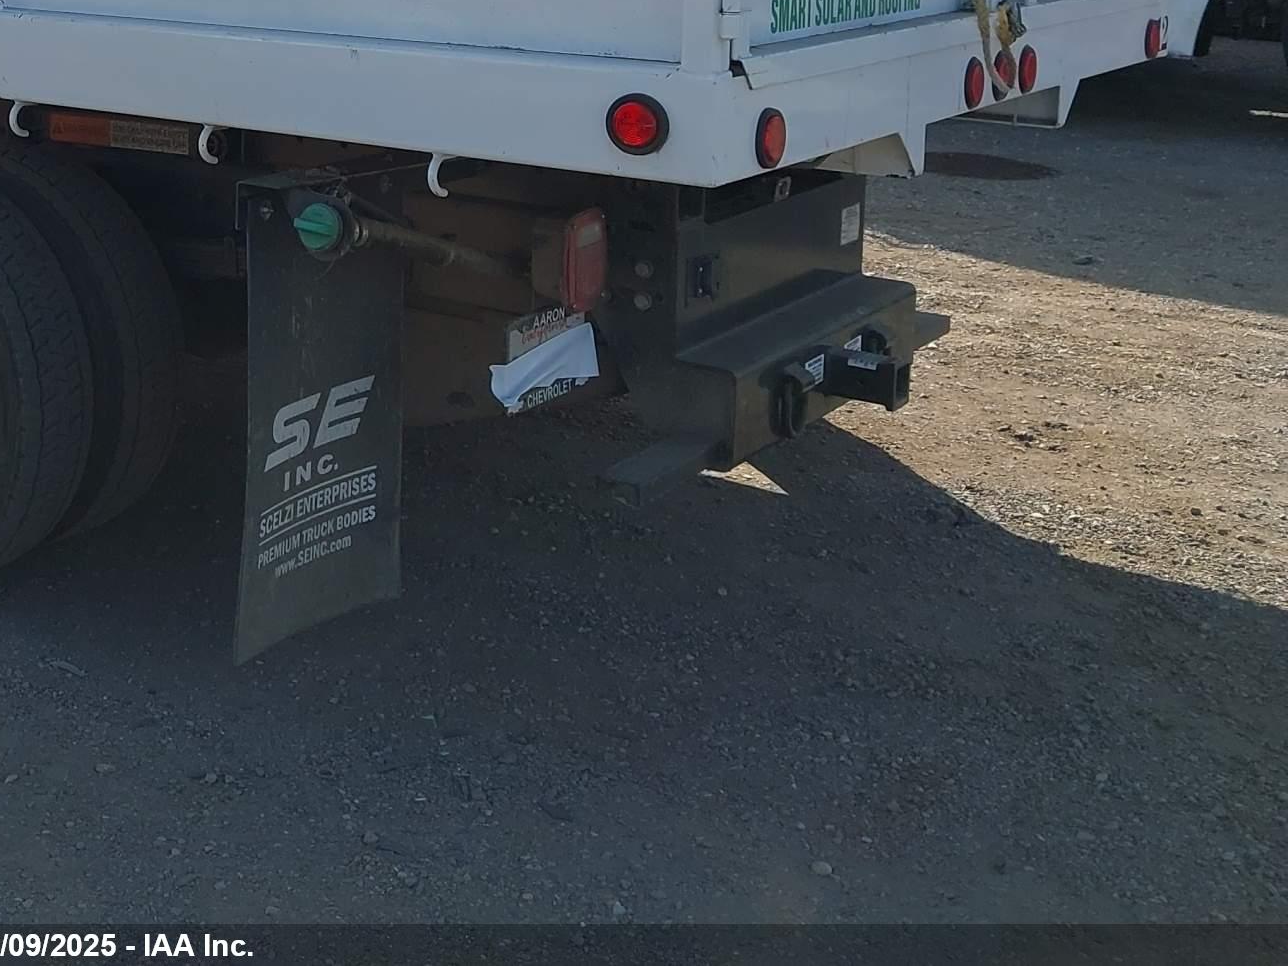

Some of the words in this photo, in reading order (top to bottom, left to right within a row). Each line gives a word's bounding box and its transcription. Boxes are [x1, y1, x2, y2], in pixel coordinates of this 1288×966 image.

[533, 307, 565, 330] AARON
[527, 378, 572, 409] CHEVROLET
[264, 374, 375, 473] SE
[283, 454, 339, 492] INC.
[259, 503, 294, 538] SCELZI
[296, 472, 376, 518] ENTERPRISES
[257, 533, 301, 569] PREMIUM
[302, 519, 334, 545] TRUCK
[336, 505, 376, 531] BODIES
[274, 535, 352, 578] www.SEINC.com
